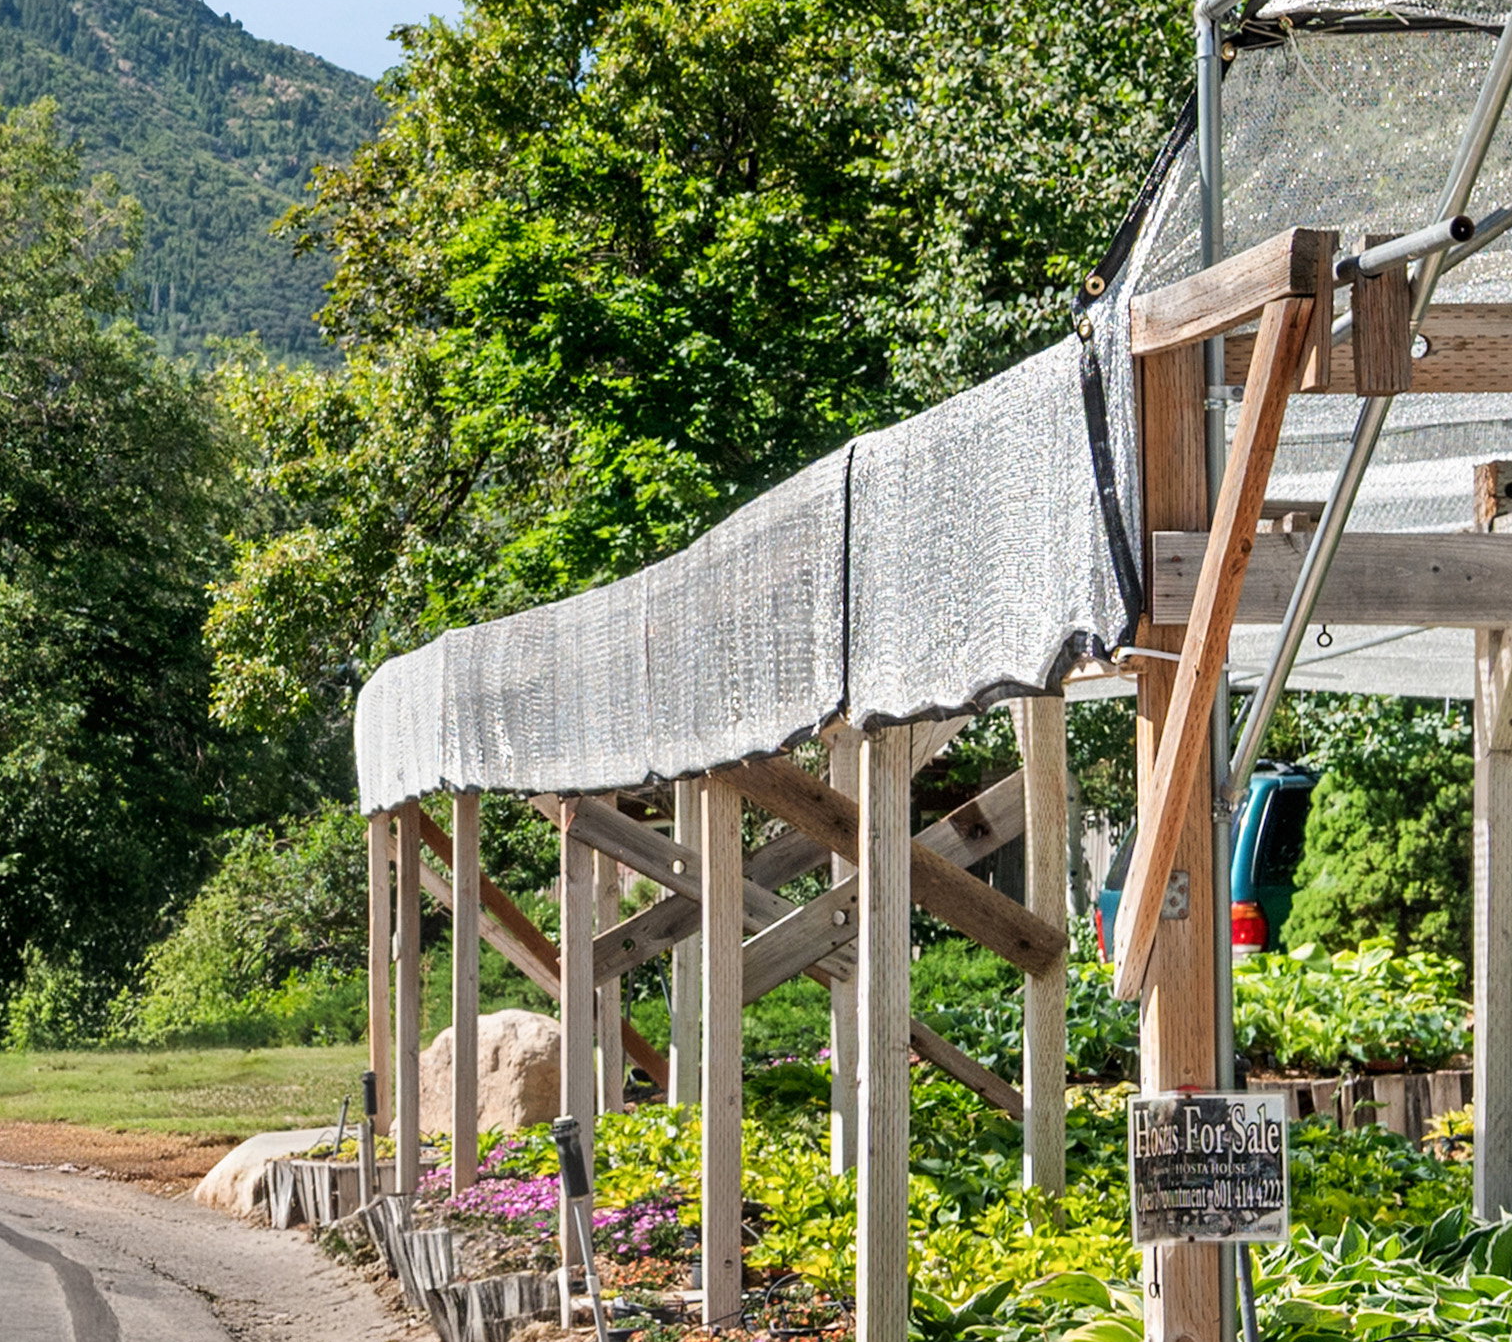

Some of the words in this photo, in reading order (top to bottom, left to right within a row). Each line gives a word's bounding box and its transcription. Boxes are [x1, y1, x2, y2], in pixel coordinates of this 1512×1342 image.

[1134, 1109, 1179, 1158] Hostas
[1183, 1106, 1225, 1154] For
[1230, 1103, 1280, 1154] Sale
[1176, 1163, 1208, 1175] HOSTA
[1210, 1163, 1247, 1175] HOUSE
[1214, 1179, 1232, 1207] 801
